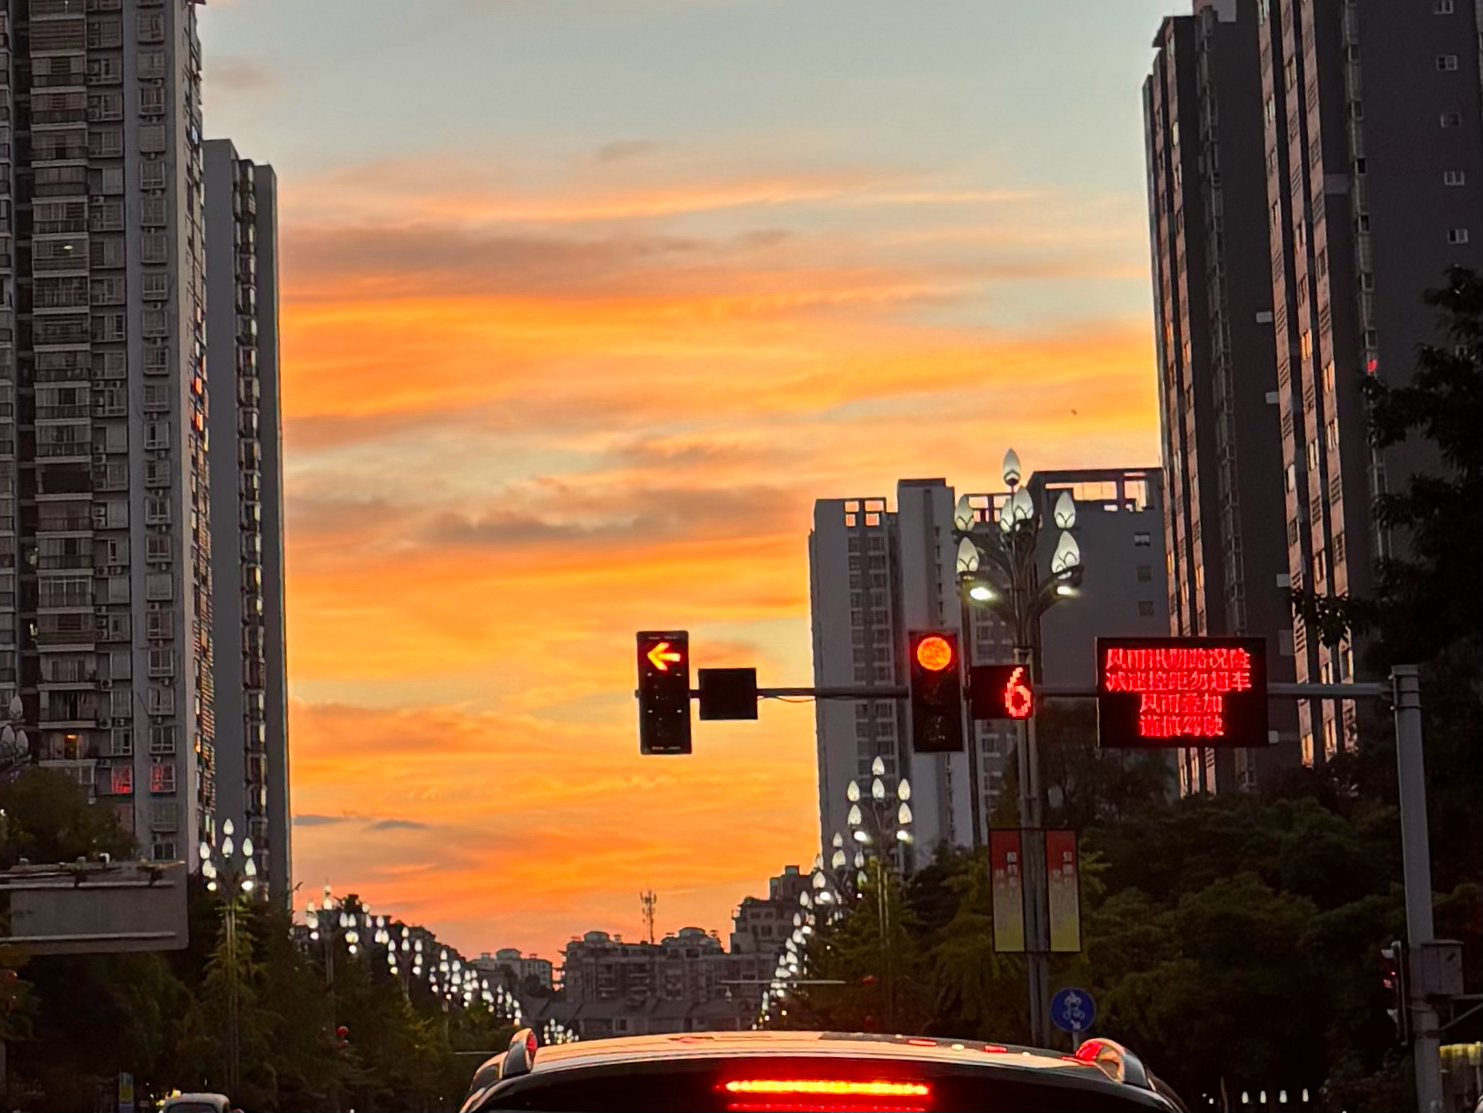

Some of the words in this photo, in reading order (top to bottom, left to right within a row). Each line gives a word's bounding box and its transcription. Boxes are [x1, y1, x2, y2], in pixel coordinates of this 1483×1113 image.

[1005, 667, 1031, 717] 6
[1106, 670, 1252, 692] 减速控距勿超车
[1140, 714, 1225, 737] 谨慎驾驶
